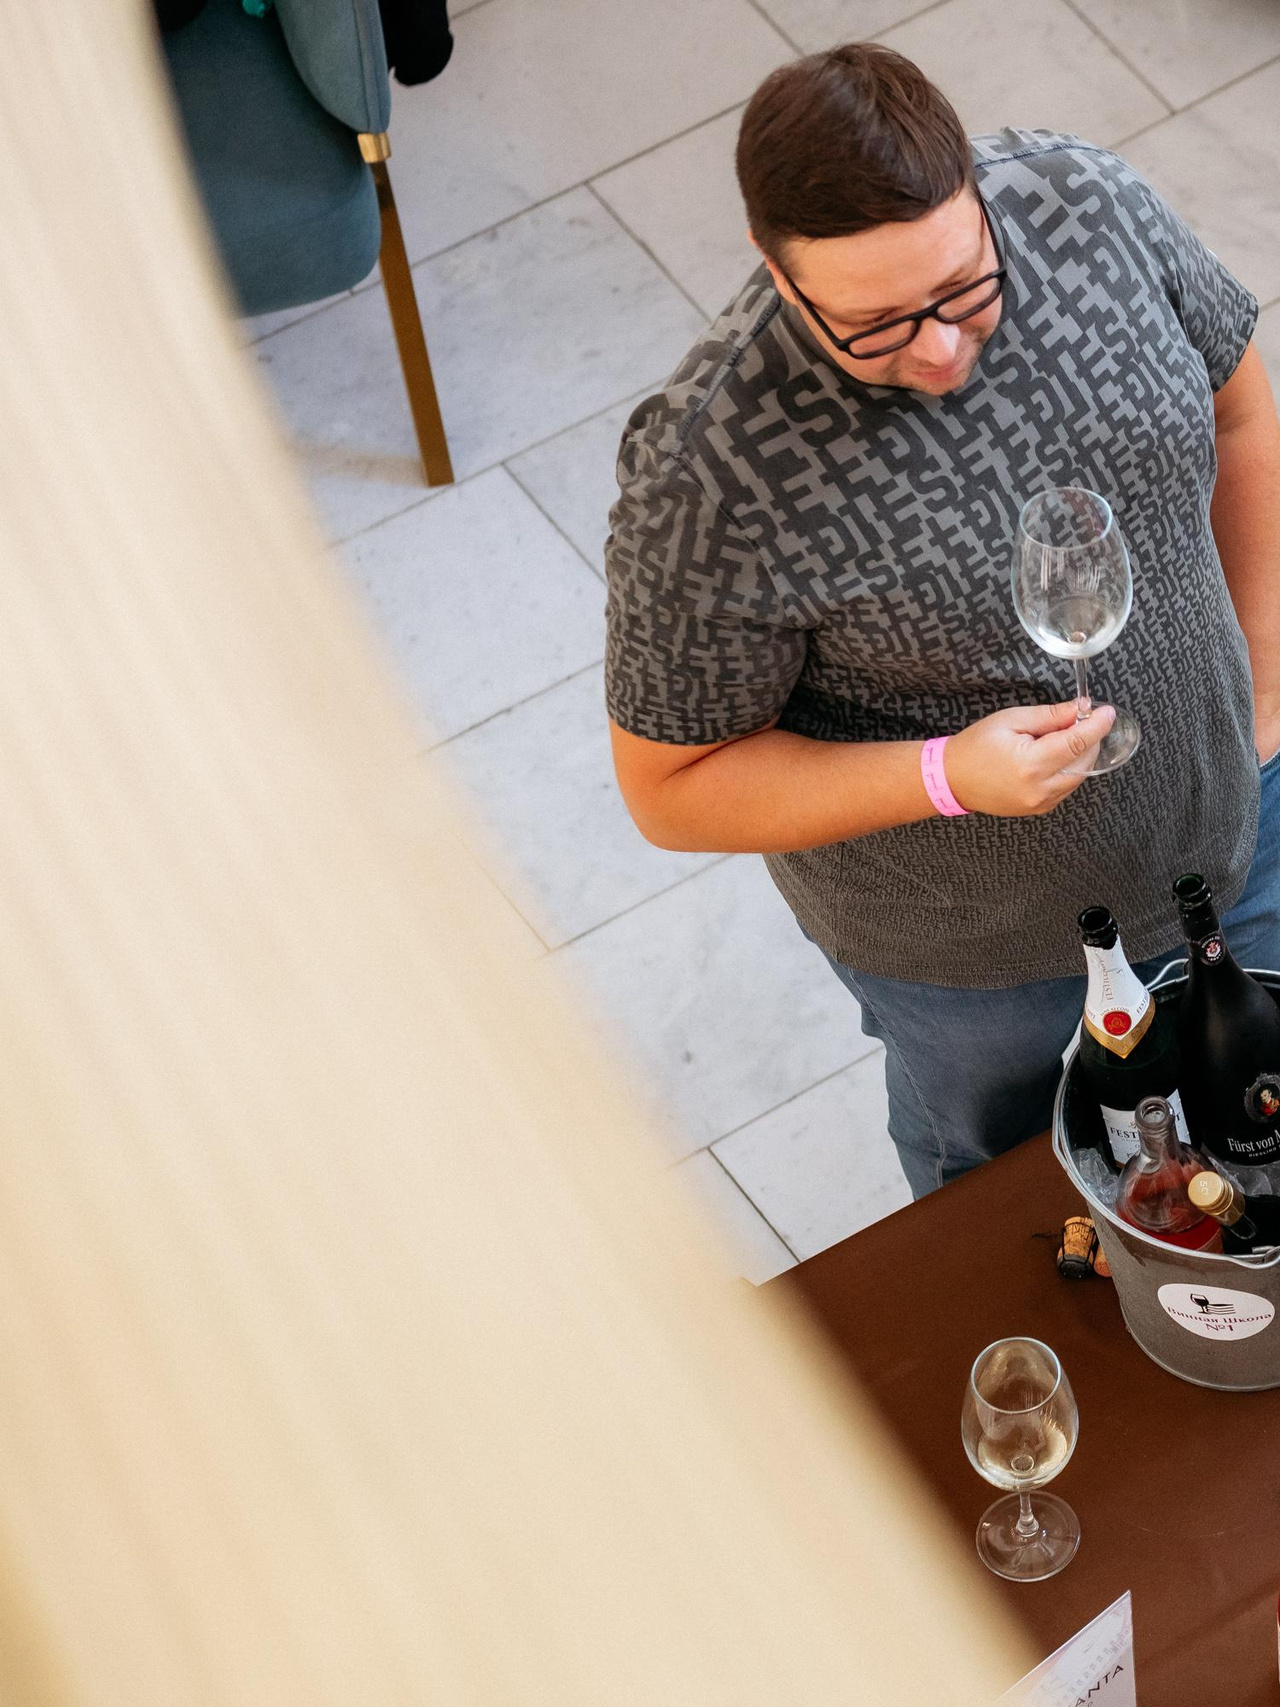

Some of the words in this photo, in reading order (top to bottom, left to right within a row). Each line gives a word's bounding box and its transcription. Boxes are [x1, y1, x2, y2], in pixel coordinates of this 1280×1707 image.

[1226, 1137, 1256, 1153] Fürst
[1255, 1136, 1275, 1150] von
[1167, 1306, 1220, 1324] Винная
[1223, 1312, 1273, 1324] Школа
